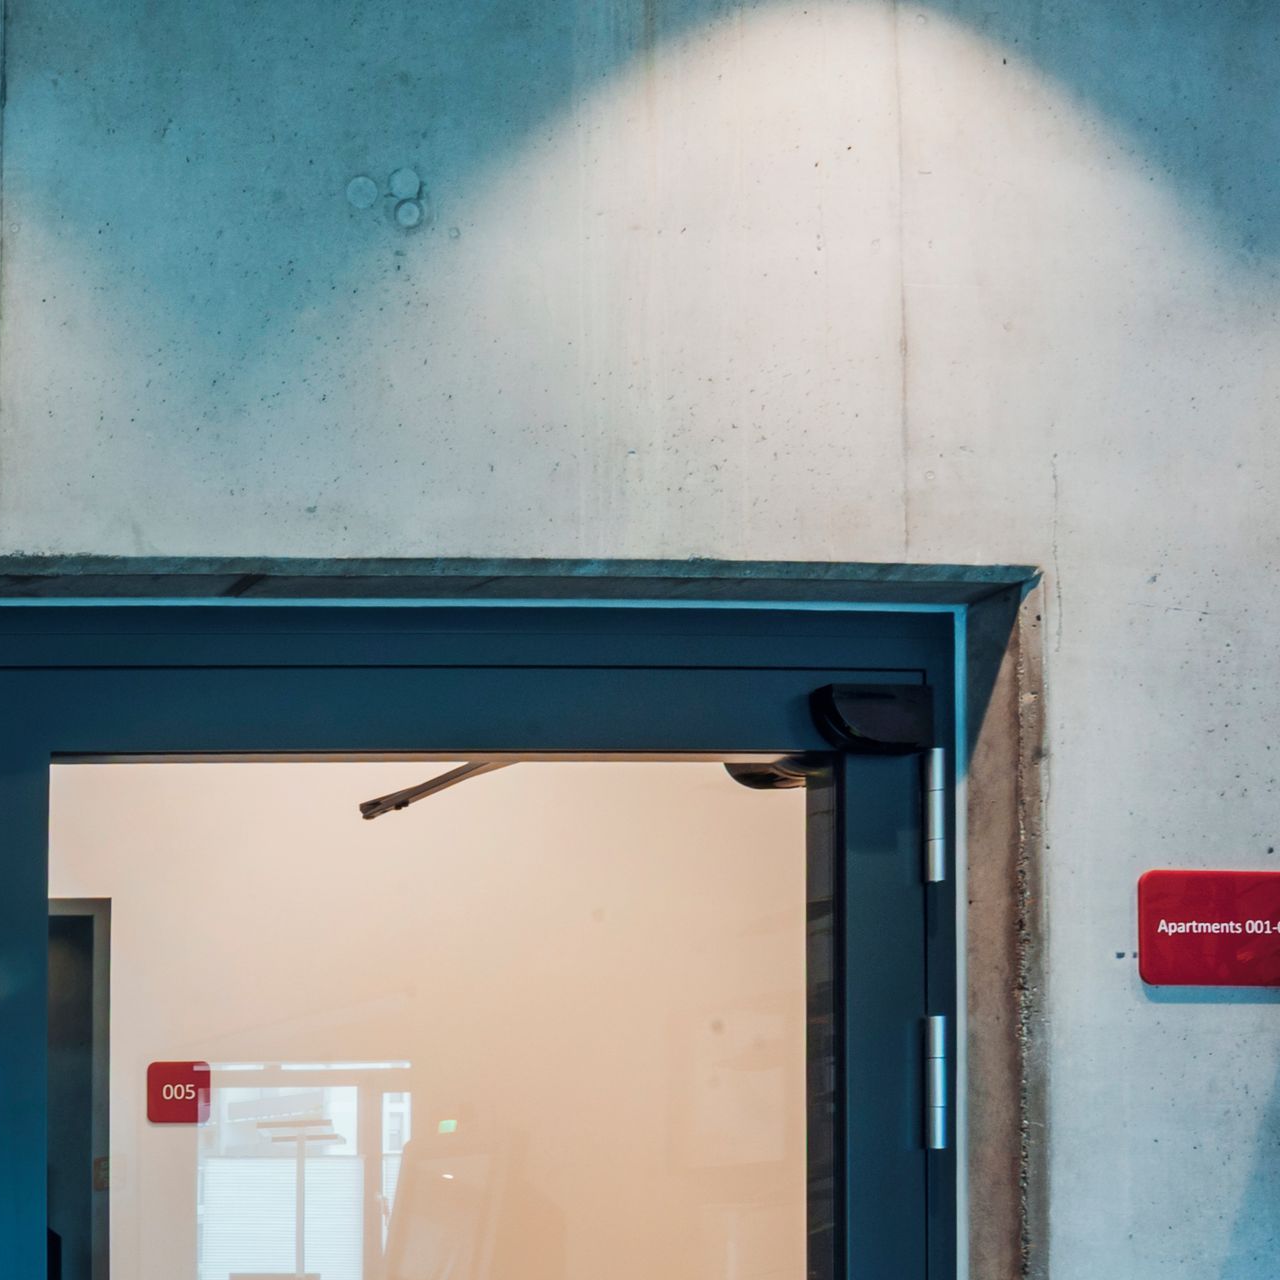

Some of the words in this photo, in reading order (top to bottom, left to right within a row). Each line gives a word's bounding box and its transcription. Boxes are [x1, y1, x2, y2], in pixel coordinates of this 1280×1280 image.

[1158, 919, 1242, 936] Apartments
[1245, 920, 1280, 934] 001-
[162, 1084, 196, 1101] 005
